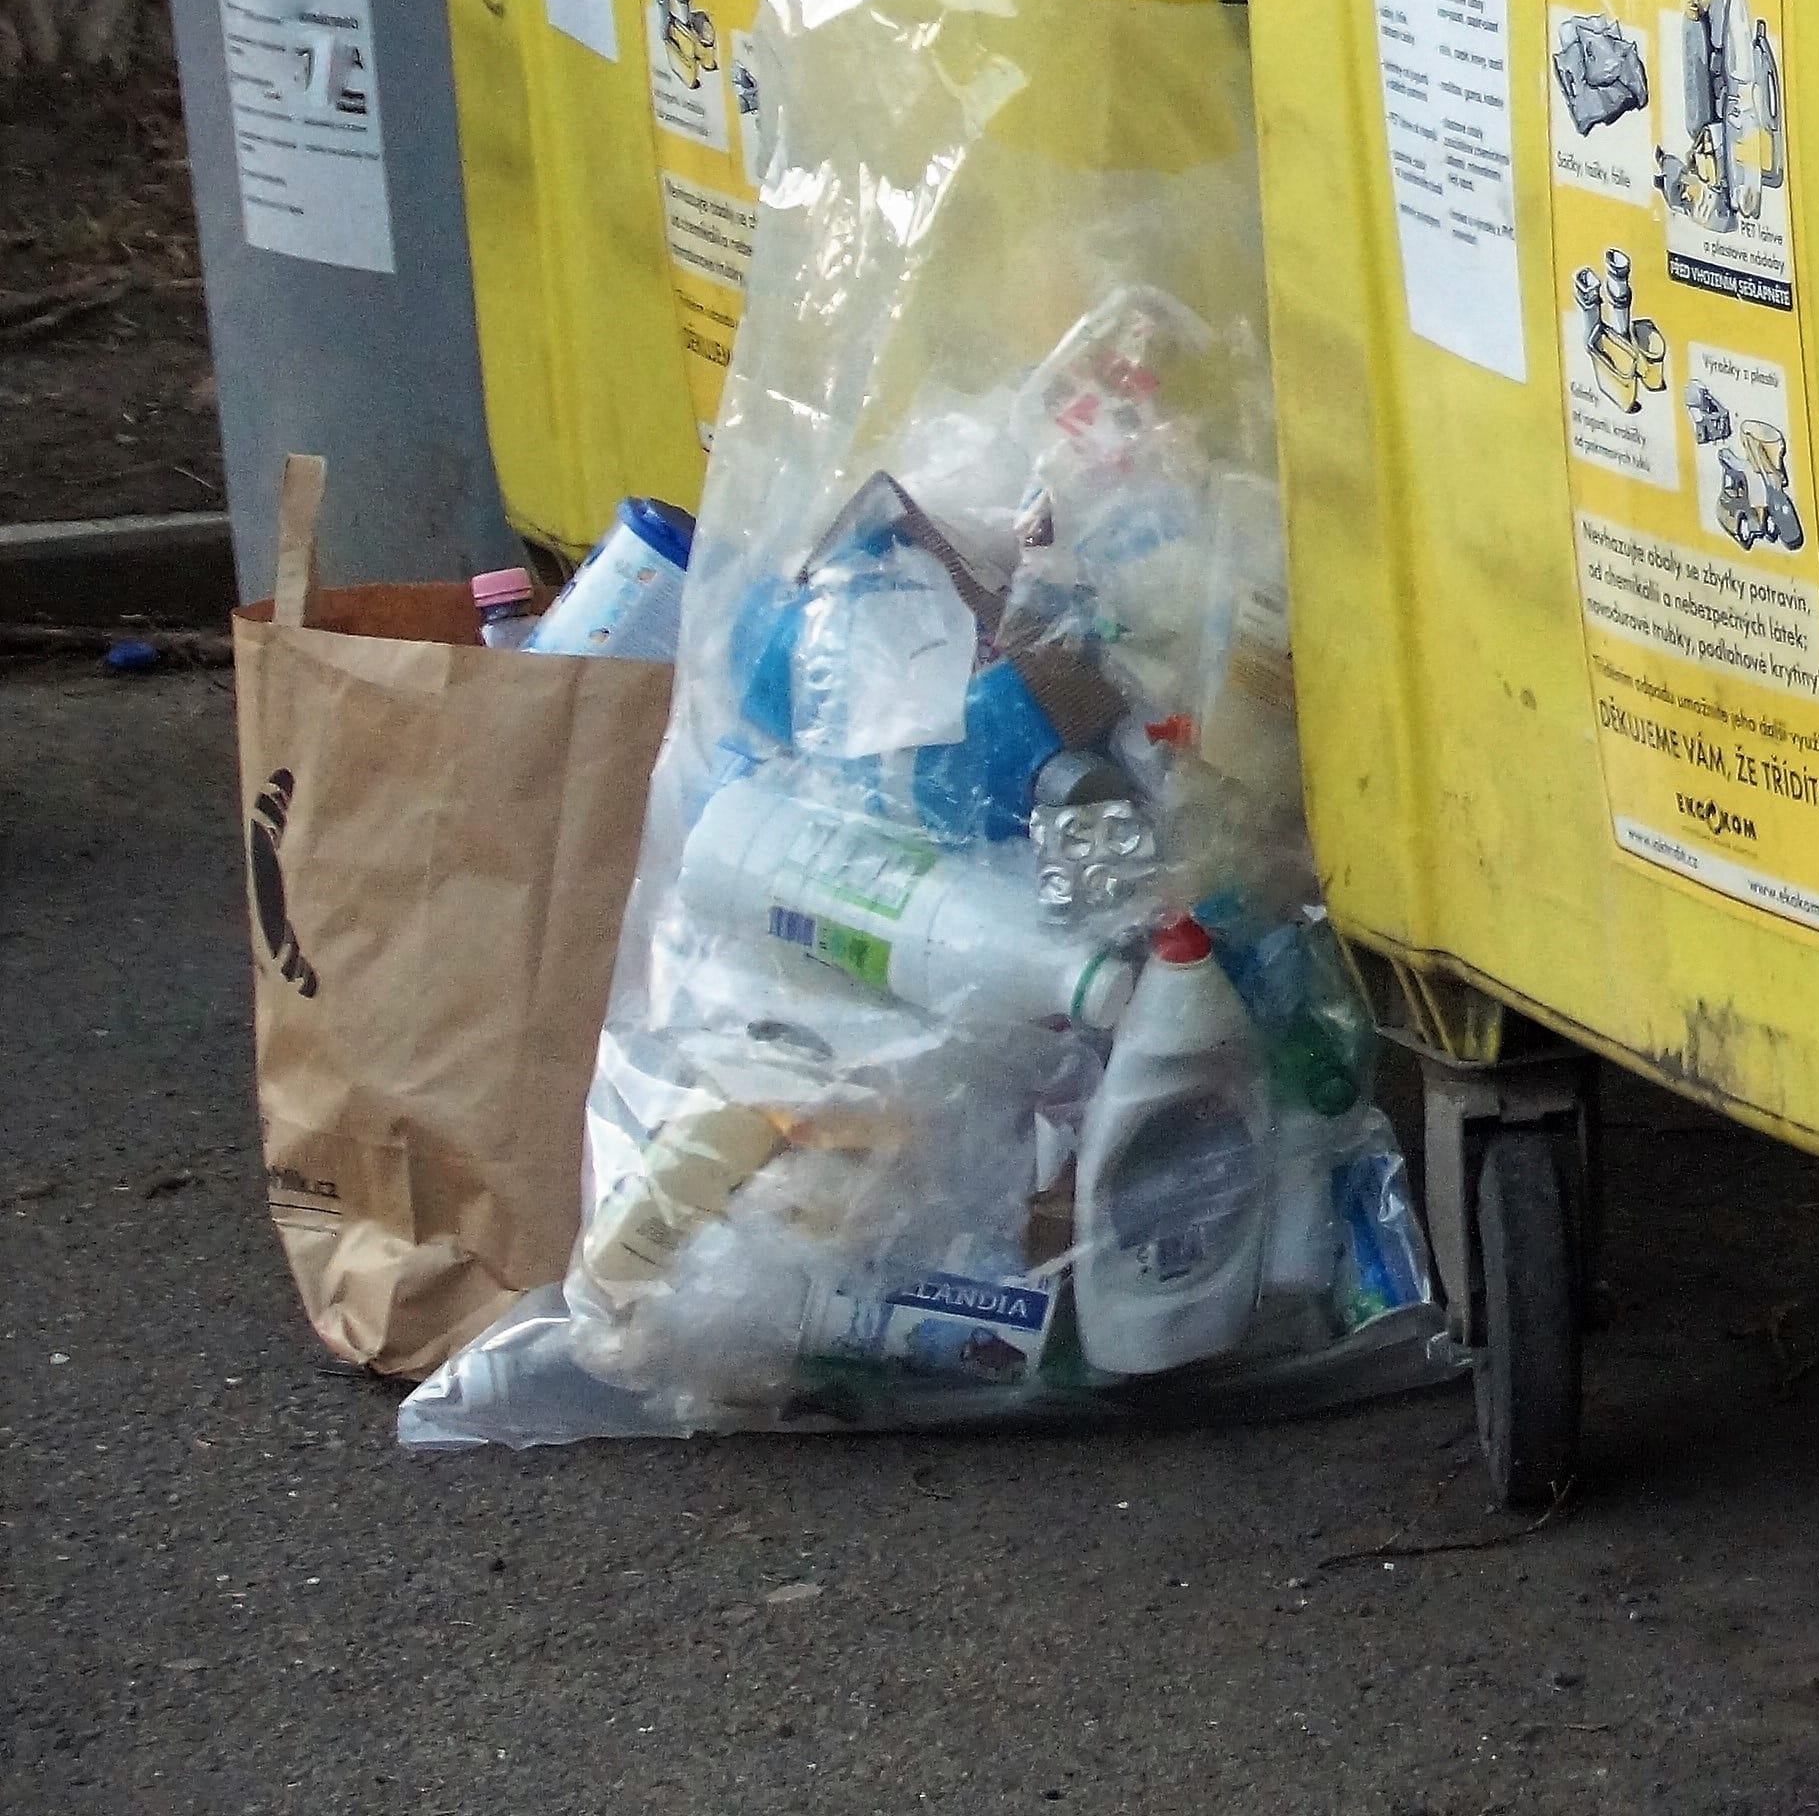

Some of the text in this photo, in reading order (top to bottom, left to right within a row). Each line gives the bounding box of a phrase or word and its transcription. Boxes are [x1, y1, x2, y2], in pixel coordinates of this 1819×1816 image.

[1646, 545, 1681, 580] obaly
[1702, 562, 1745, 600] zbytky
[1749, 581, 1811, 616] potravin,
[1663, 592, 1672, 608] a
[1674, 591, 1766, 639] nebezpečných
[1698, 637, 1767, 675] podlahové
[1598, 695, 1681, 760] DĚKUJEME
[1735, 743, 1759, 787] ŽE
